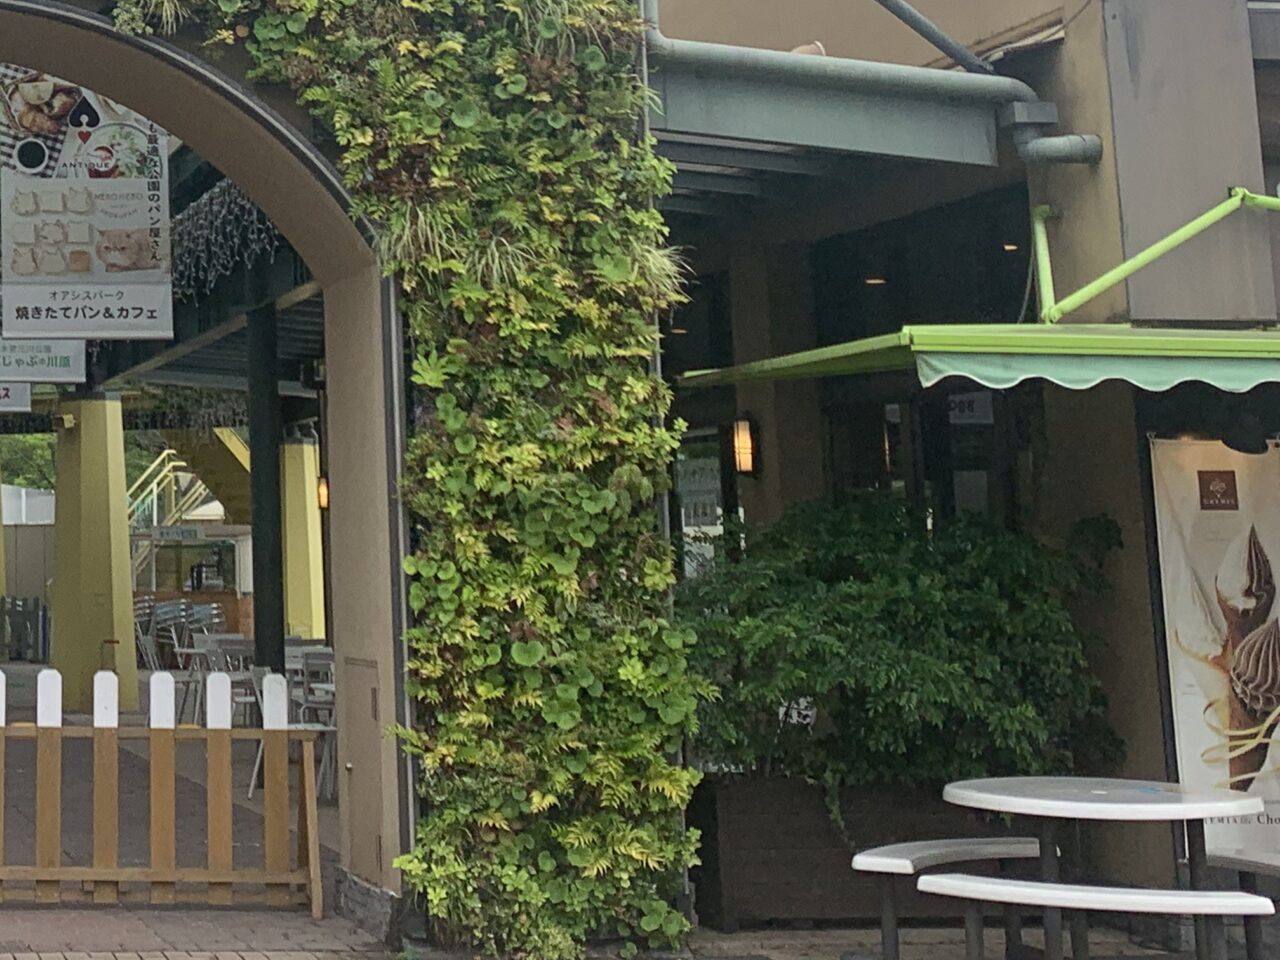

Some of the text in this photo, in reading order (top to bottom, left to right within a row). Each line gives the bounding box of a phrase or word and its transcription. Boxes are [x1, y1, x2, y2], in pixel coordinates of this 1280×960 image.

[61, 161, 111, 169] ANTIQUE
[48, 290, 125, 302] オアシスパーク
[15, 304, 158, 321] 焼きたてパン&カフェ
